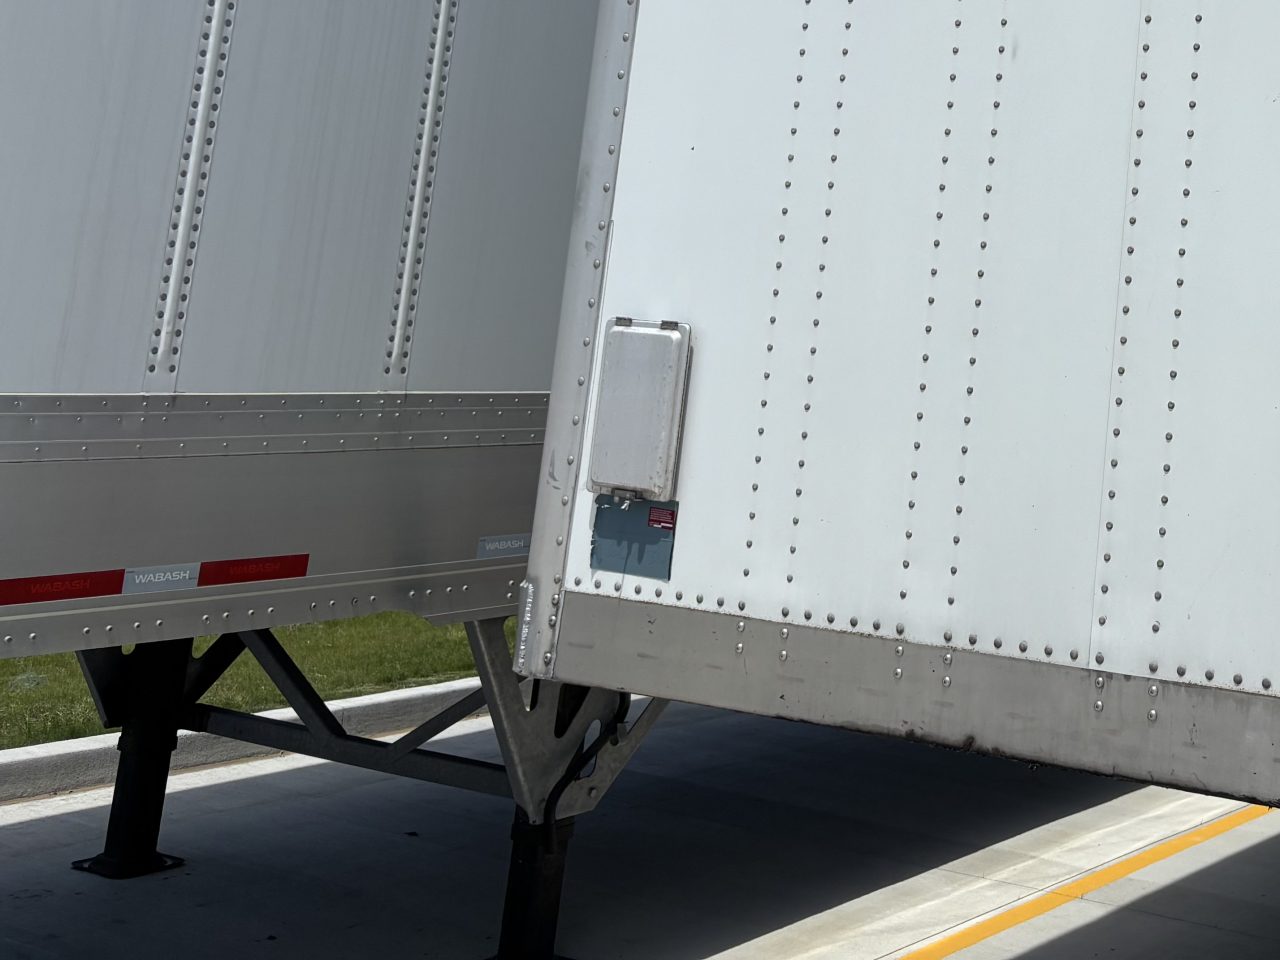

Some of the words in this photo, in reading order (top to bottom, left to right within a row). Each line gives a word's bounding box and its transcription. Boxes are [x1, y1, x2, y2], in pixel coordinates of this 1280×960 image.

[485, 539, 524, 551] WABASH
[229, 561, 281, 576] WABASH
[135, 569, 190, 584] WABASH
[30, 578, 91, 594] WABASH
